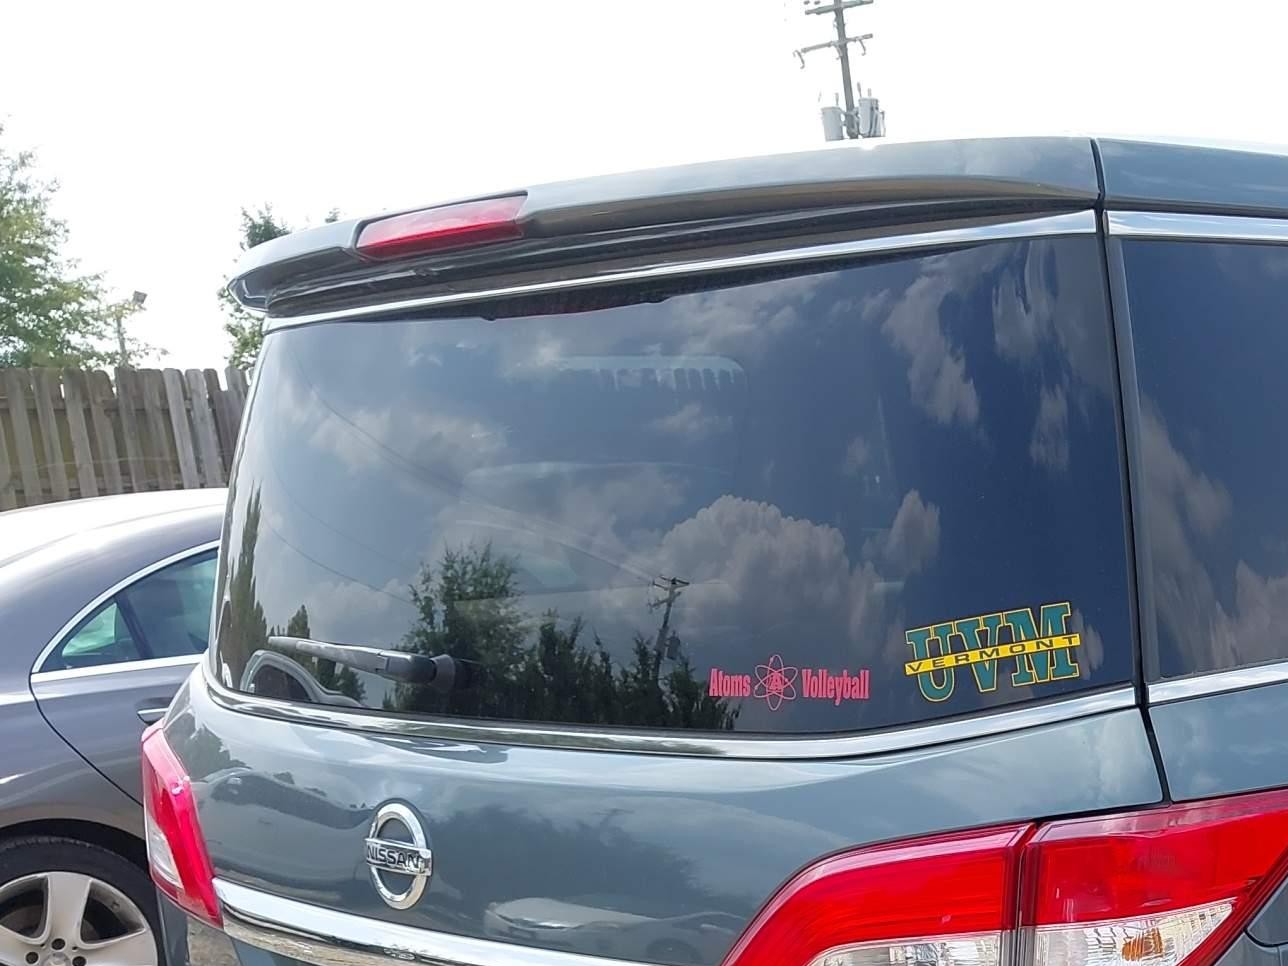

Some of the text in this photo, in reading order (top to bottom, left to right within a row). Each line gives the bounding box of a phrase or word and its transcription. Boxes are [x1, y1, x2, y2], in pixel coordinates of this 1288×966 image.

[905, 602, 1080, 702] UVM
[907, 635, 1078, 673] VERMONT
[709, 668, 750, 697] Atoms
[801, 668, 869, 706] Volleyball
[366, 843, 424, 872] NISSAN
